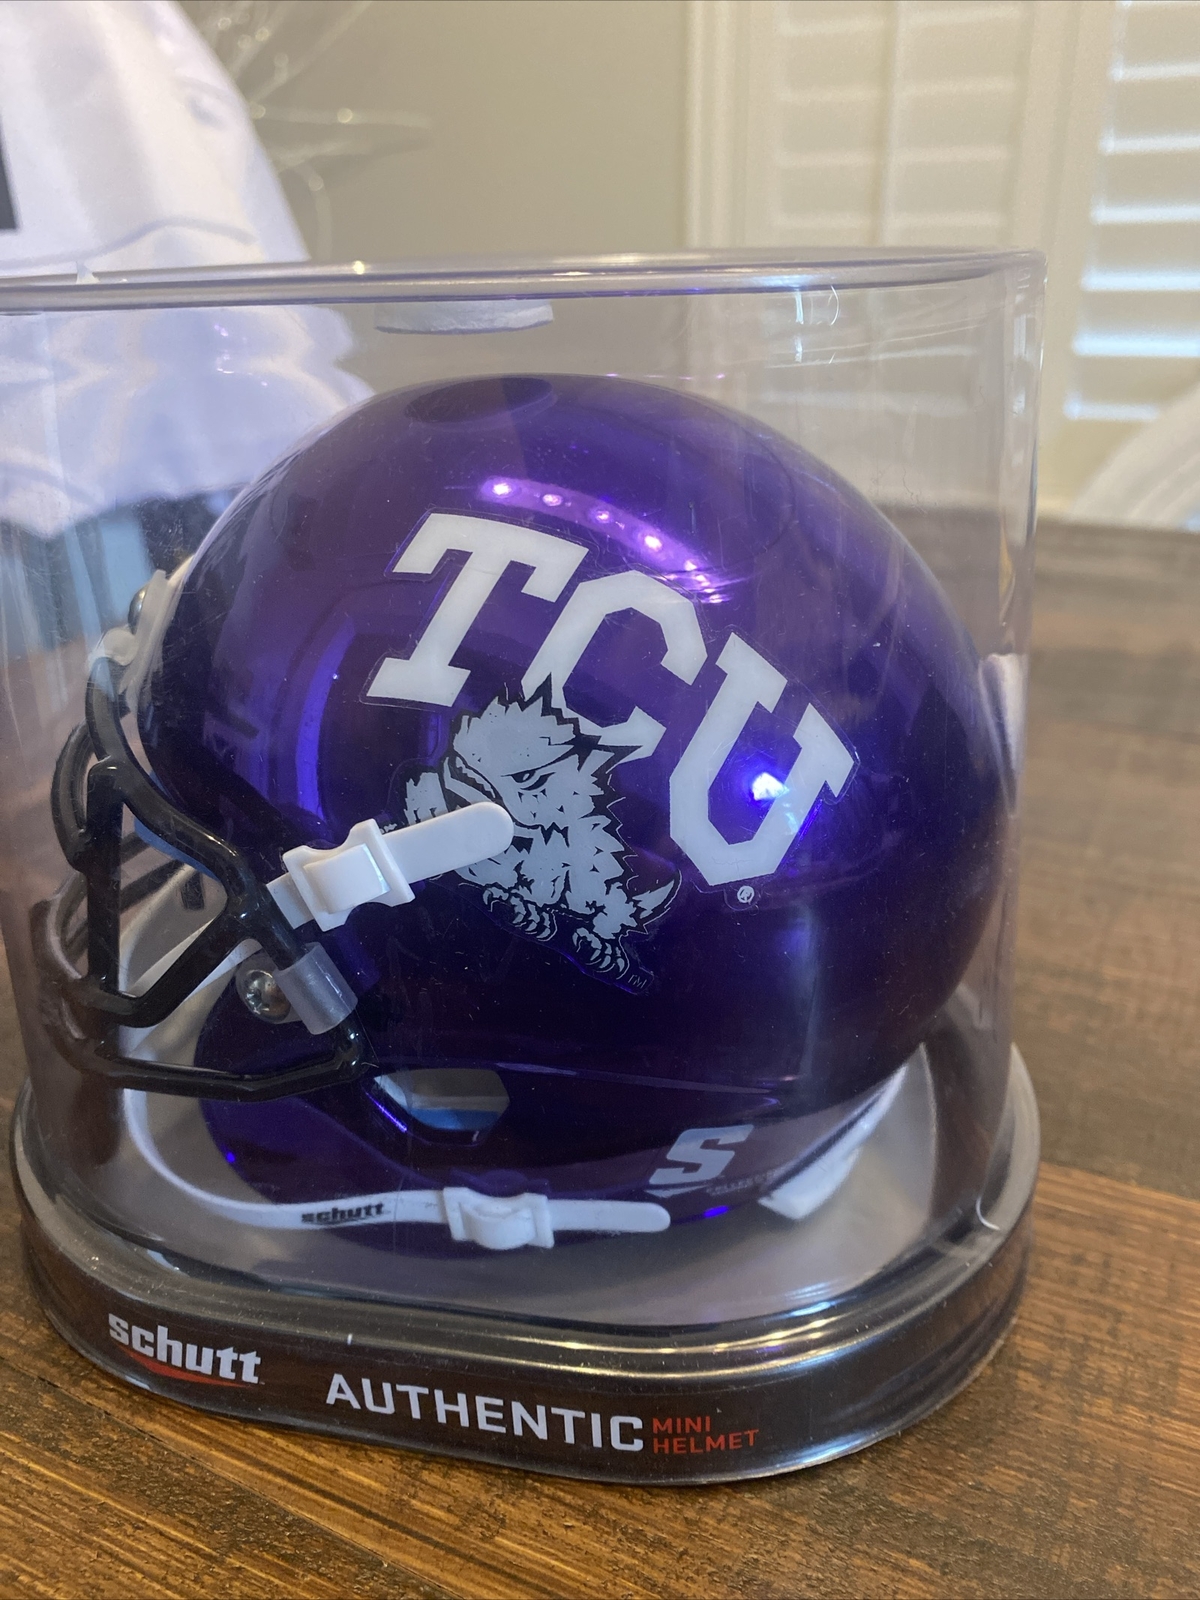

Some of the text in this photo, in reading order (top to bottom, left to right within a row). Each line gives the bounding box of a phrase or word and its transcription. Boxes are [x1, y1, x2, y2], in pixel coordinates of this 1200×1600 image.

[367, 513, 855, 886] TCU
[301, 1202, 384, 1223] schutt
[108, 1313, 261, 1384] schutt
[326, 1373, 643, 1452] AUTHENTIC
[652, 1416, 711, 1434] MINI
[653, 1430, 760, 1455] HELMET
